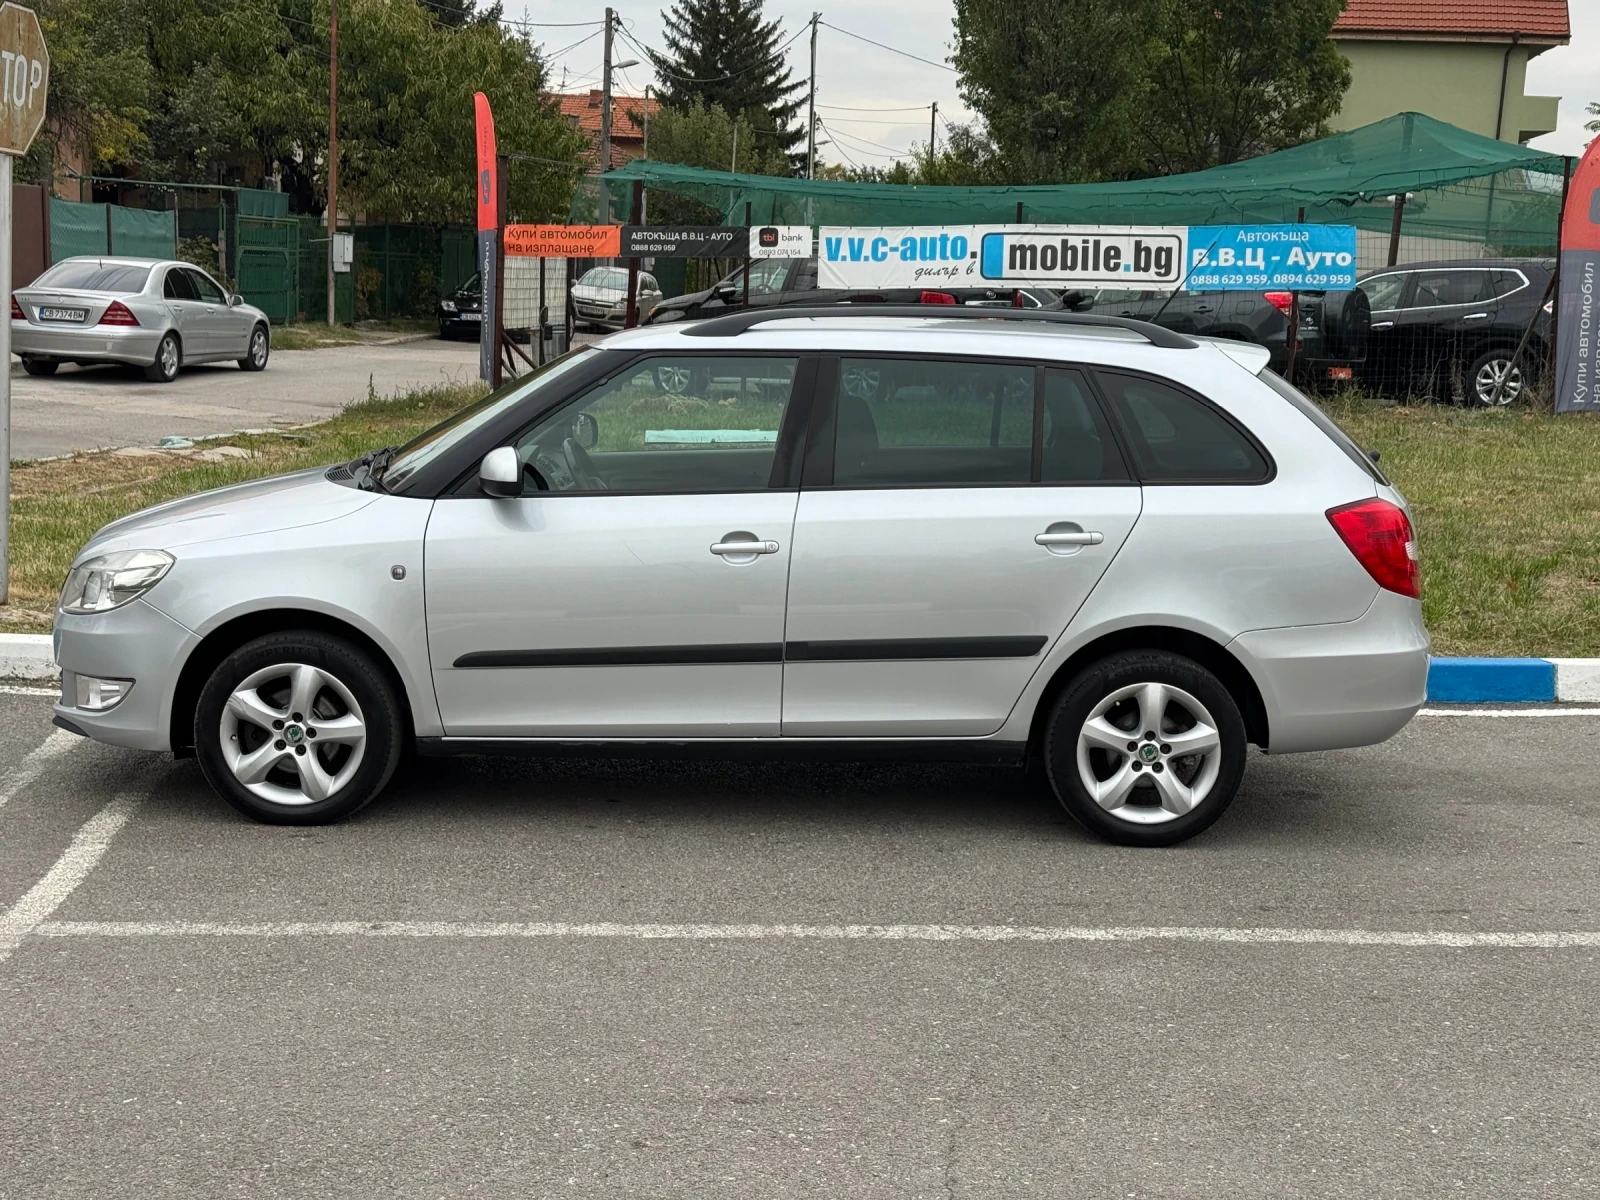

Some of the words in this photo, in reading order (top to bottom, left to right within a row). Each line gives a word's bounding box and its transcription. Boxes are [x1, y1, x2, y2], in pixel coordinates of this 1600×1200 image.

[2, 50, 42, 109] TOP
[508, 228, 537, 240] Купи
[540, 227, 608, 240] автомобил
[631, 231, 680, 241] АВТОКЪЩА
[681, 232, 705, 241] В.В.Ц
[711, 232, 733, 241] АУТО
[763, 233, 775, 242] tbi
[1236, 230, 1309, 243] Автокъща
[508, 243, 522, 252] на
[525, 244, 595, 254] изплащане
[1008, 239, 1173, 277] mobile.bg
[1192, 247, 1265, 270] В.В.Ц
[1286, 246, 1352, 270] Ауто
[914, 265, 959, 281] дилър
[1191, 275, 1220, 285] 0888
[1221, 275, 1243, 284] 629
[1245, 275, 1271, 286] 959,
[1273, 274, 1303, 284] 0894
[1305, 274, 1327, 284] 629
[1329, 274, 1352, 284] 959
[1578, 262, 1595, 358] автомобил
[1573, 362, 1588, 403] Купи
